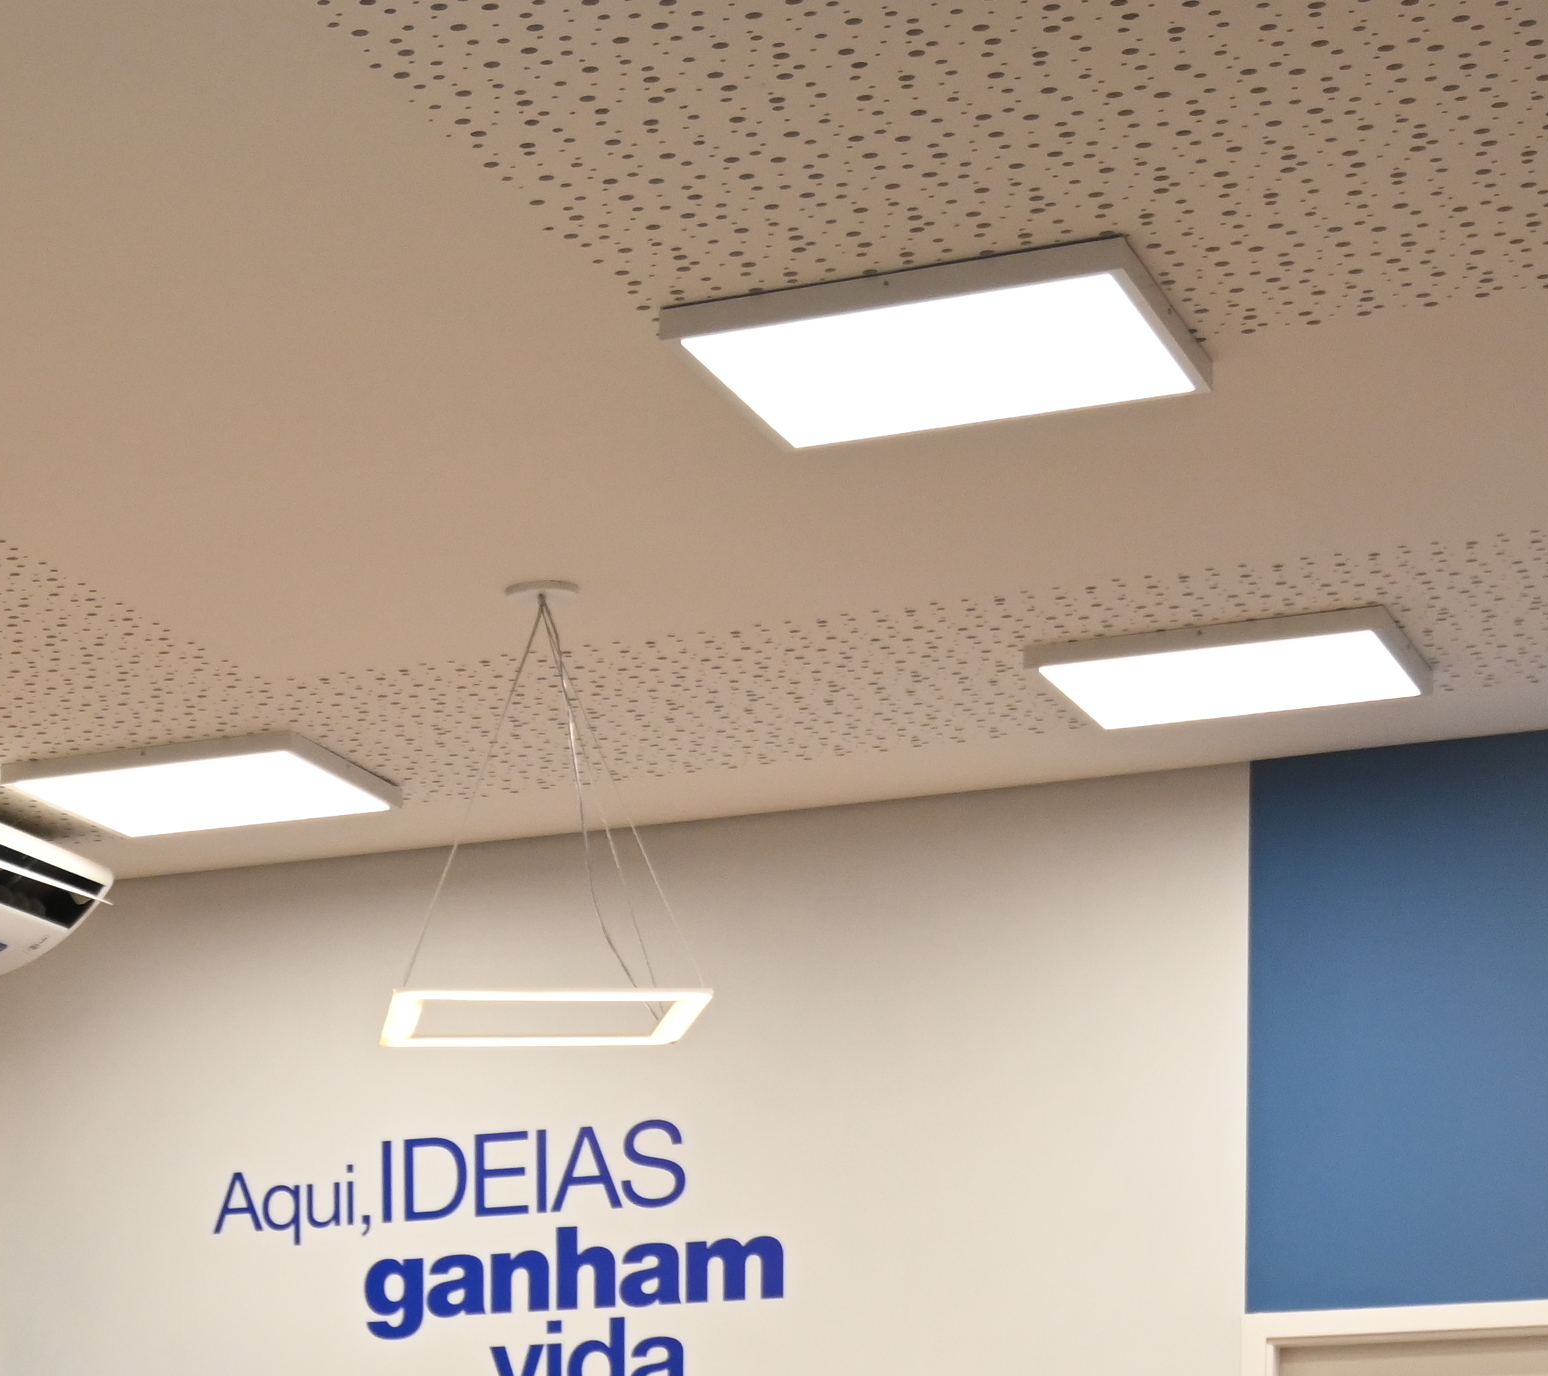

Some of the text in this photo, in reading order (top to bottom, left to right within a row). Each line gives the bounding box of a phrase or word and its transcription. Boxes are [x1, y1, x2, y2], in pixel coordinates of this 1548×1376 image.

[213, 1119, 686, 1246] Aqui, IDEIAS
[364, 1226, 785, 1340] ganham
